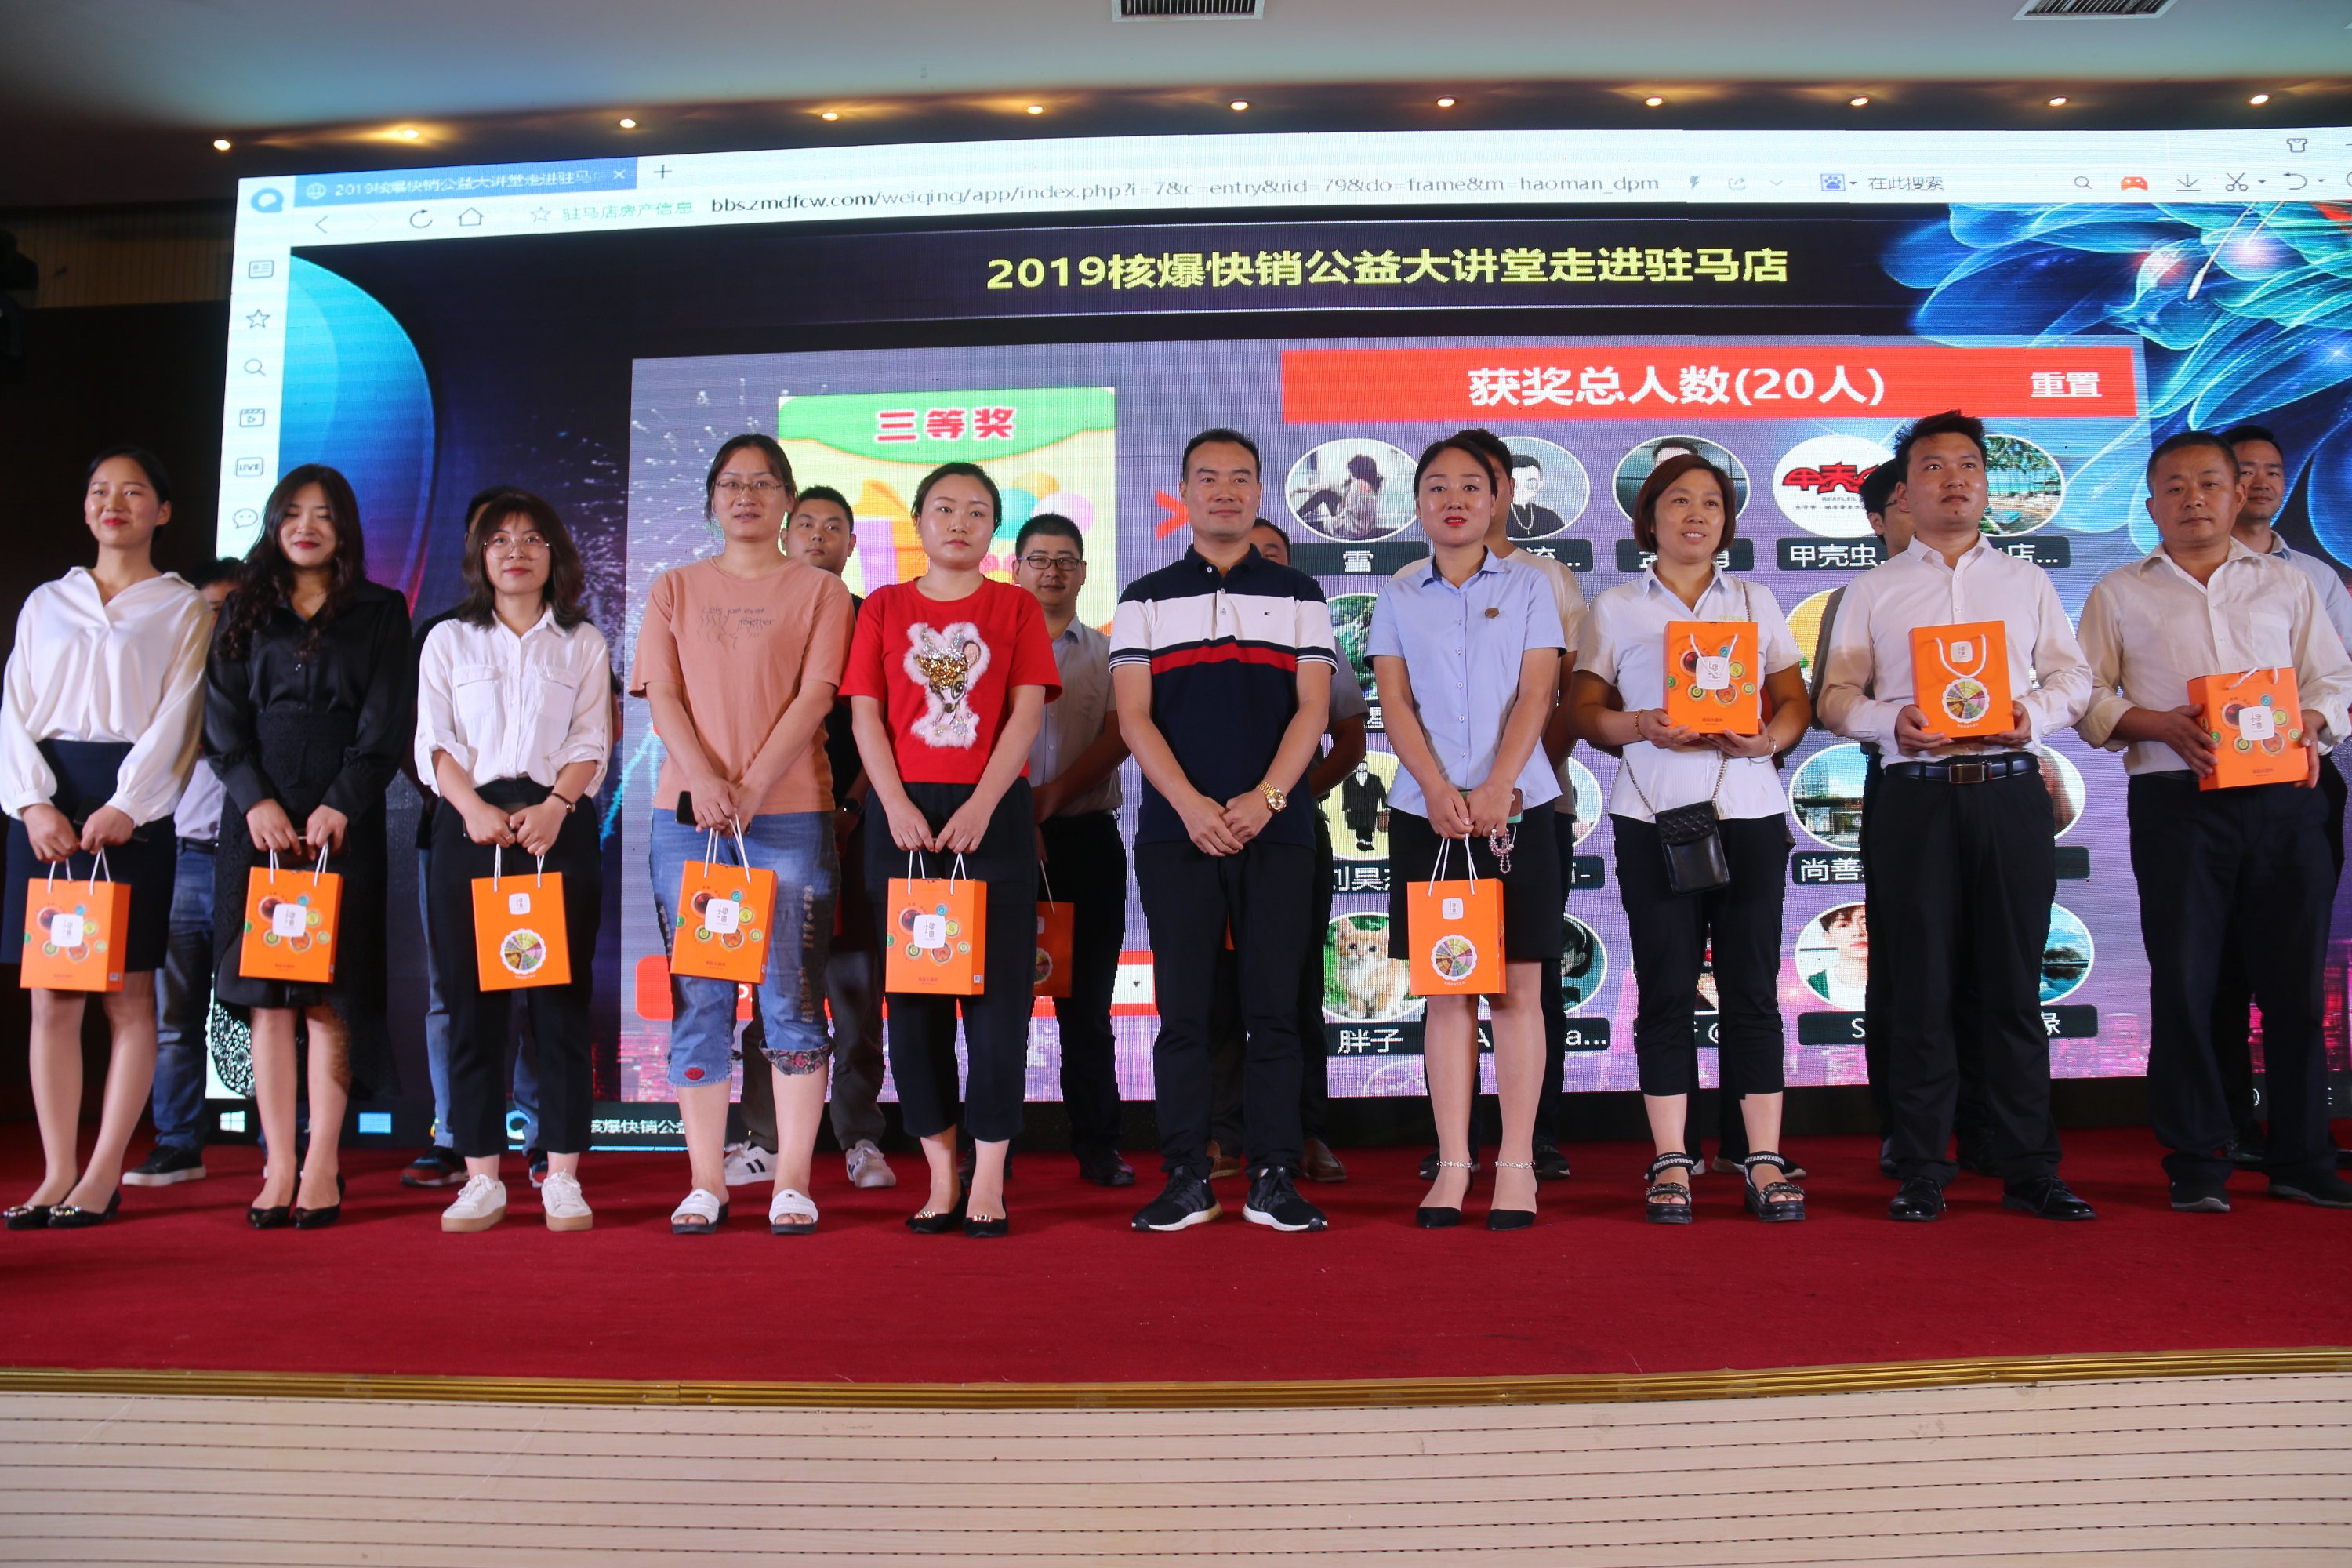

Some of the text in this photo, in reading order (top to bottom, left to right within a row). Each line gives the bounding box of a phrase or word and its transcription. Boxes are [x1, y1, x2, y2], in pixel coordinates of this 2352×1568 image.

[1868, 176, 1944, 191] 在此搜索
[563, 201, 694, 221] 驻马店房产信息
[986, 247, 1788, 291] 2019核爆快销公益大讲堂走进驻马店
[1468, 365, 1884, 408] 获奖总人数(20人)
[2030, 372, 2103, 398] 重置
[875, 407, 1017, 441] 三等奖
[1342, 549, 1374, 573] 雪
[1800, 856, 1864, 882] 尚善
[1338, 1029, 1403, 1054] 胖子
